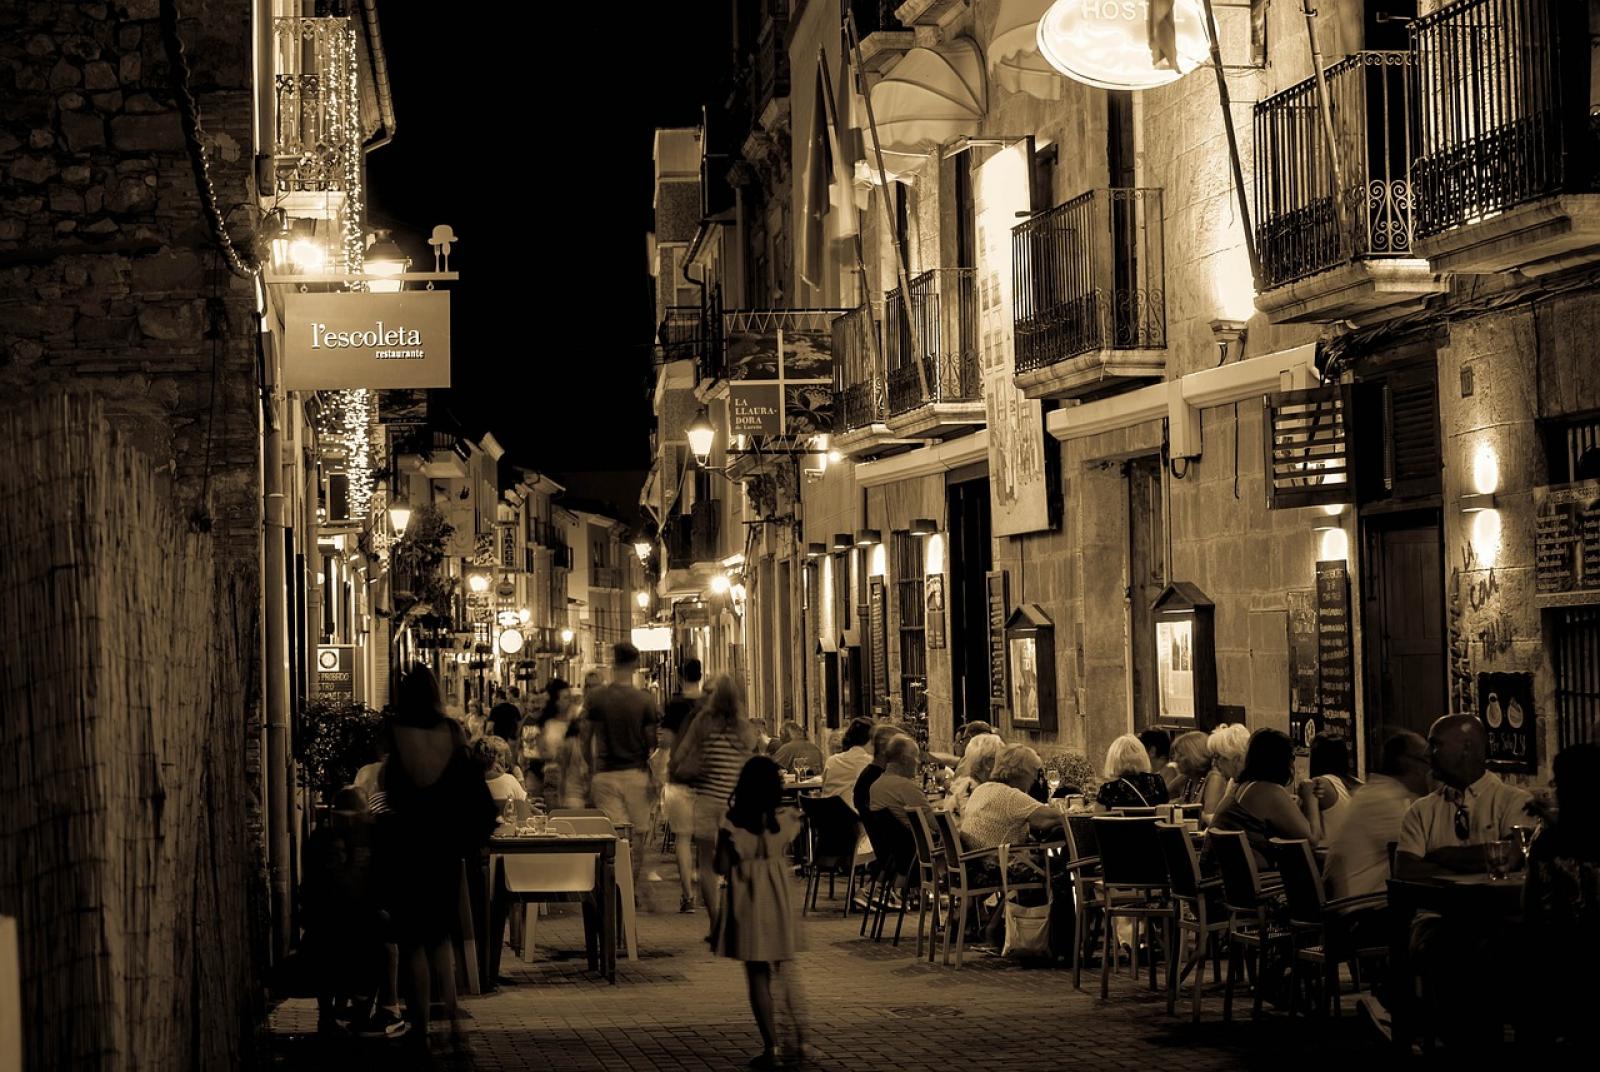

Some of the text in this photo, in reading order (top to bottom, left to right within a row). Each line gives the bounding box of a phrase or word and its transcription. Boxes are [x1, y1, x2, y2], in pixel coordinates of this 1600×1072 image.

[1080, 0, 1186, 22] HOSTL
[311, 320, 423, 349] l'escoleta
[375, 349, 425, 360] restaurante
[735, 398, 748, 407] LA
[735, 416, 763, 425] DORA
